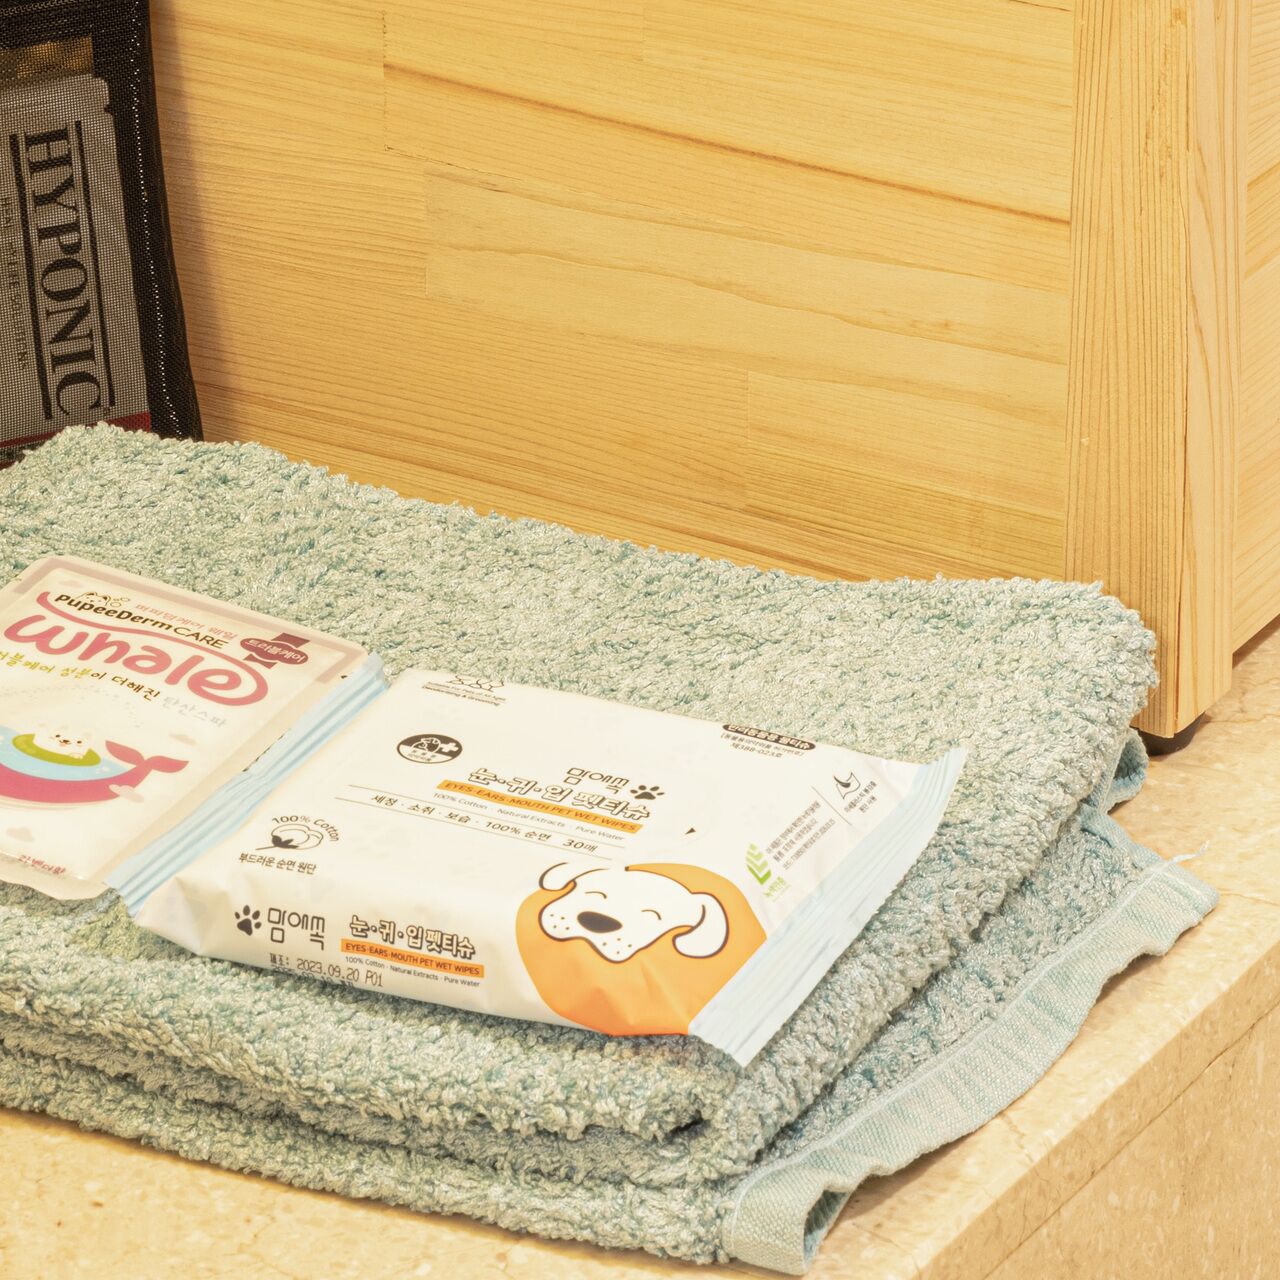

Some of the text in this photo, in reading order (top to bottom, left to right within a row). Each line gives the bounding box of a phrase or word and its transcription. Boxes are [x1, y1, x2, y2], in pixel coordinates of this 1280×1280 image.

[25, 128, 102, 416] HYPONIC
[4, 614, 268, 706] whale
[247, 639, 306, 663] 트러블케어
[61, 667, 107, 681] 성분이
[111, 675, 161, 702] 더해진
[163, 696, 227, 728] 탄산스파
[433, 792, 624, 841] 100% Cotton Natural Extracts Pure Water
[550, 805, 573, 817] PET
[574, 810, 600, 822] WET
[601, 816, 637, 831] WIPES
[572, 792, 650, 821] 펫티슈
[272, 814, 340, 842] 100% Cotton
[371, 794, 598, 853] 세정 소취 보습 100% 순면 30매
[239, 852, 317, 875] 부드러운 순면 원단
[425, 929, 476, 960] 펫티슈
[296, 957, 360, 982] 2023.09.20
[365, 970, 384, 988] P01
[345, 956, 481, 988] 100% Cotton Natural Extracts Pure Water
[419, 957, 435, 969] PET
[435, 960, 453, 972] WET
[454, 964, 480, 976] WIPES
